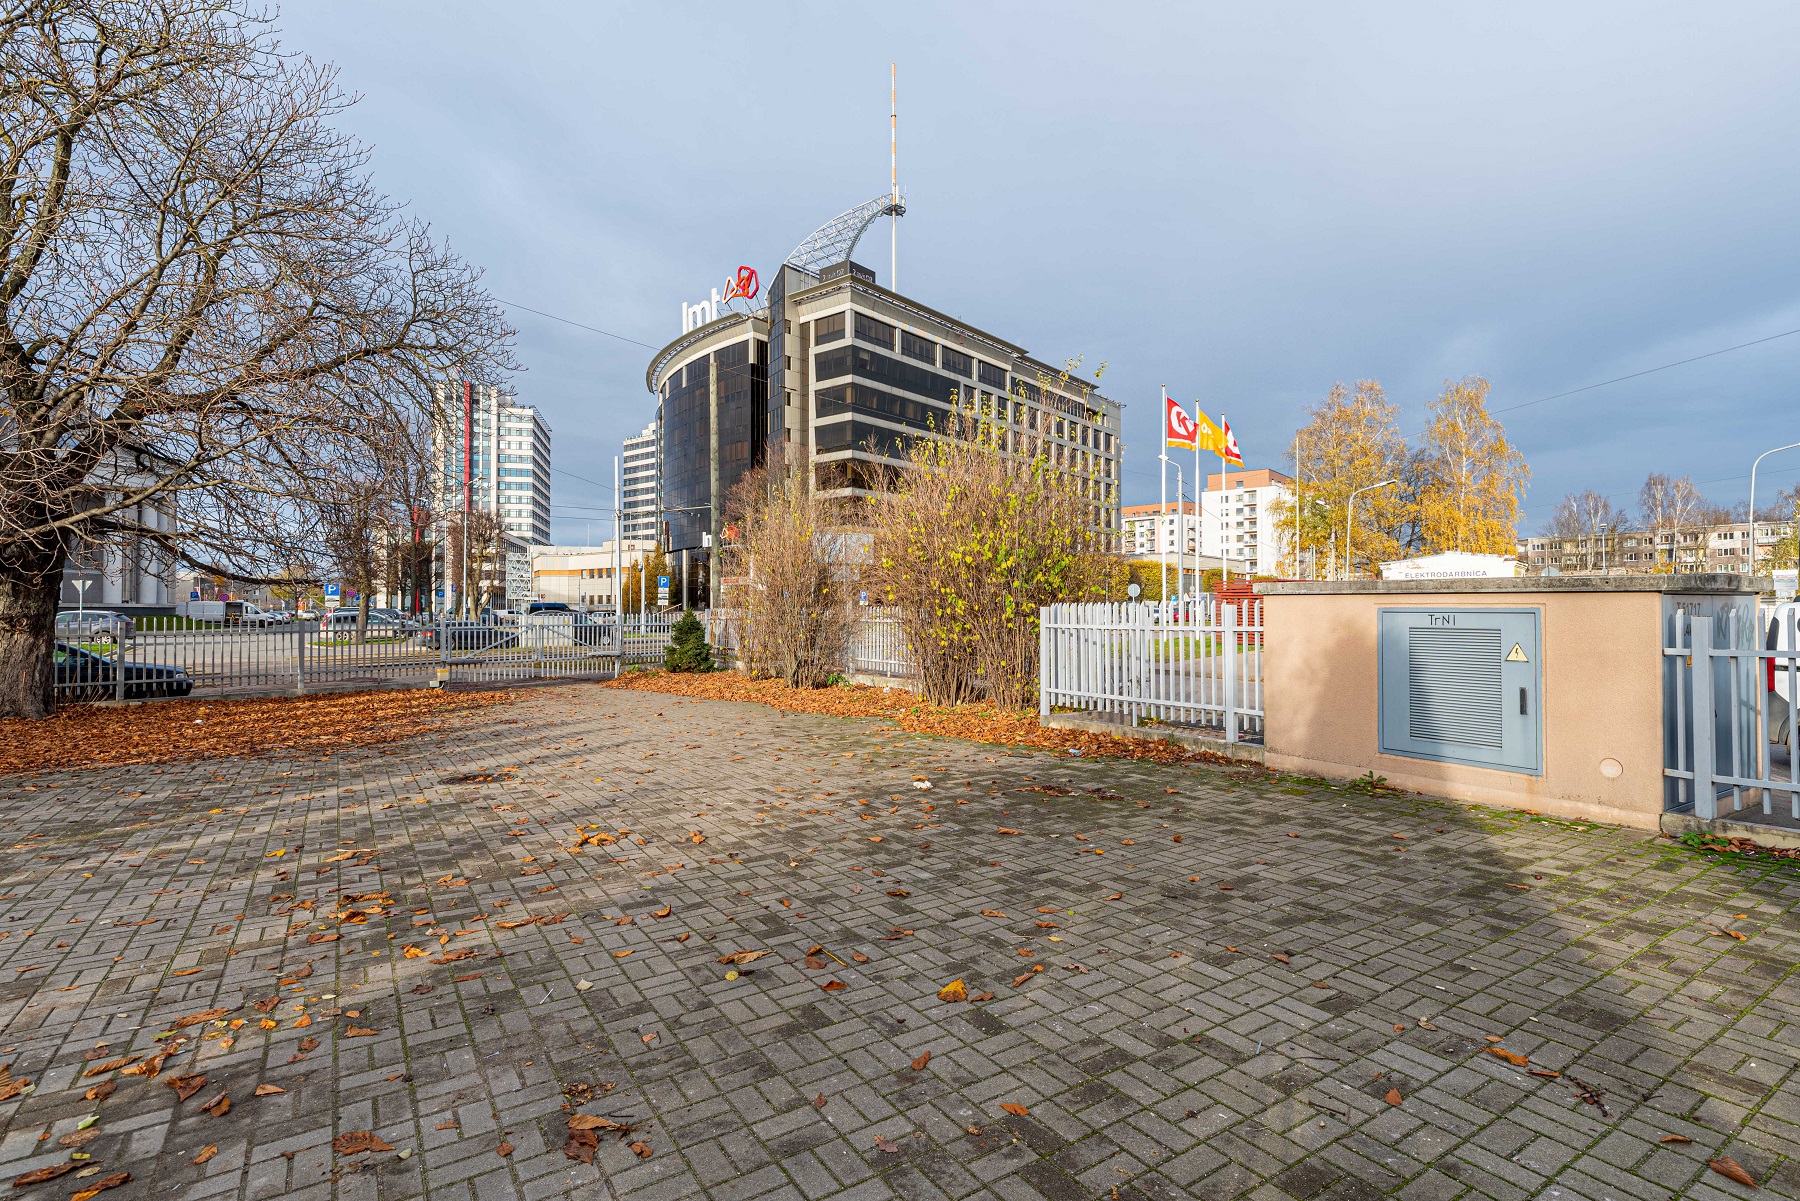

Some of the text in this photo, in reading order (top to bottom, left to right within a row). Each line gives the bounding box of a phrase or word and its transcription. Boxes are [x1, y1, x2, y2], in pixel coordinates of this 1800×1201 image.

[682, 287, 720, 336] lmt
[661, 577, 667, 586] P
[328, 584, 336, 595] P
